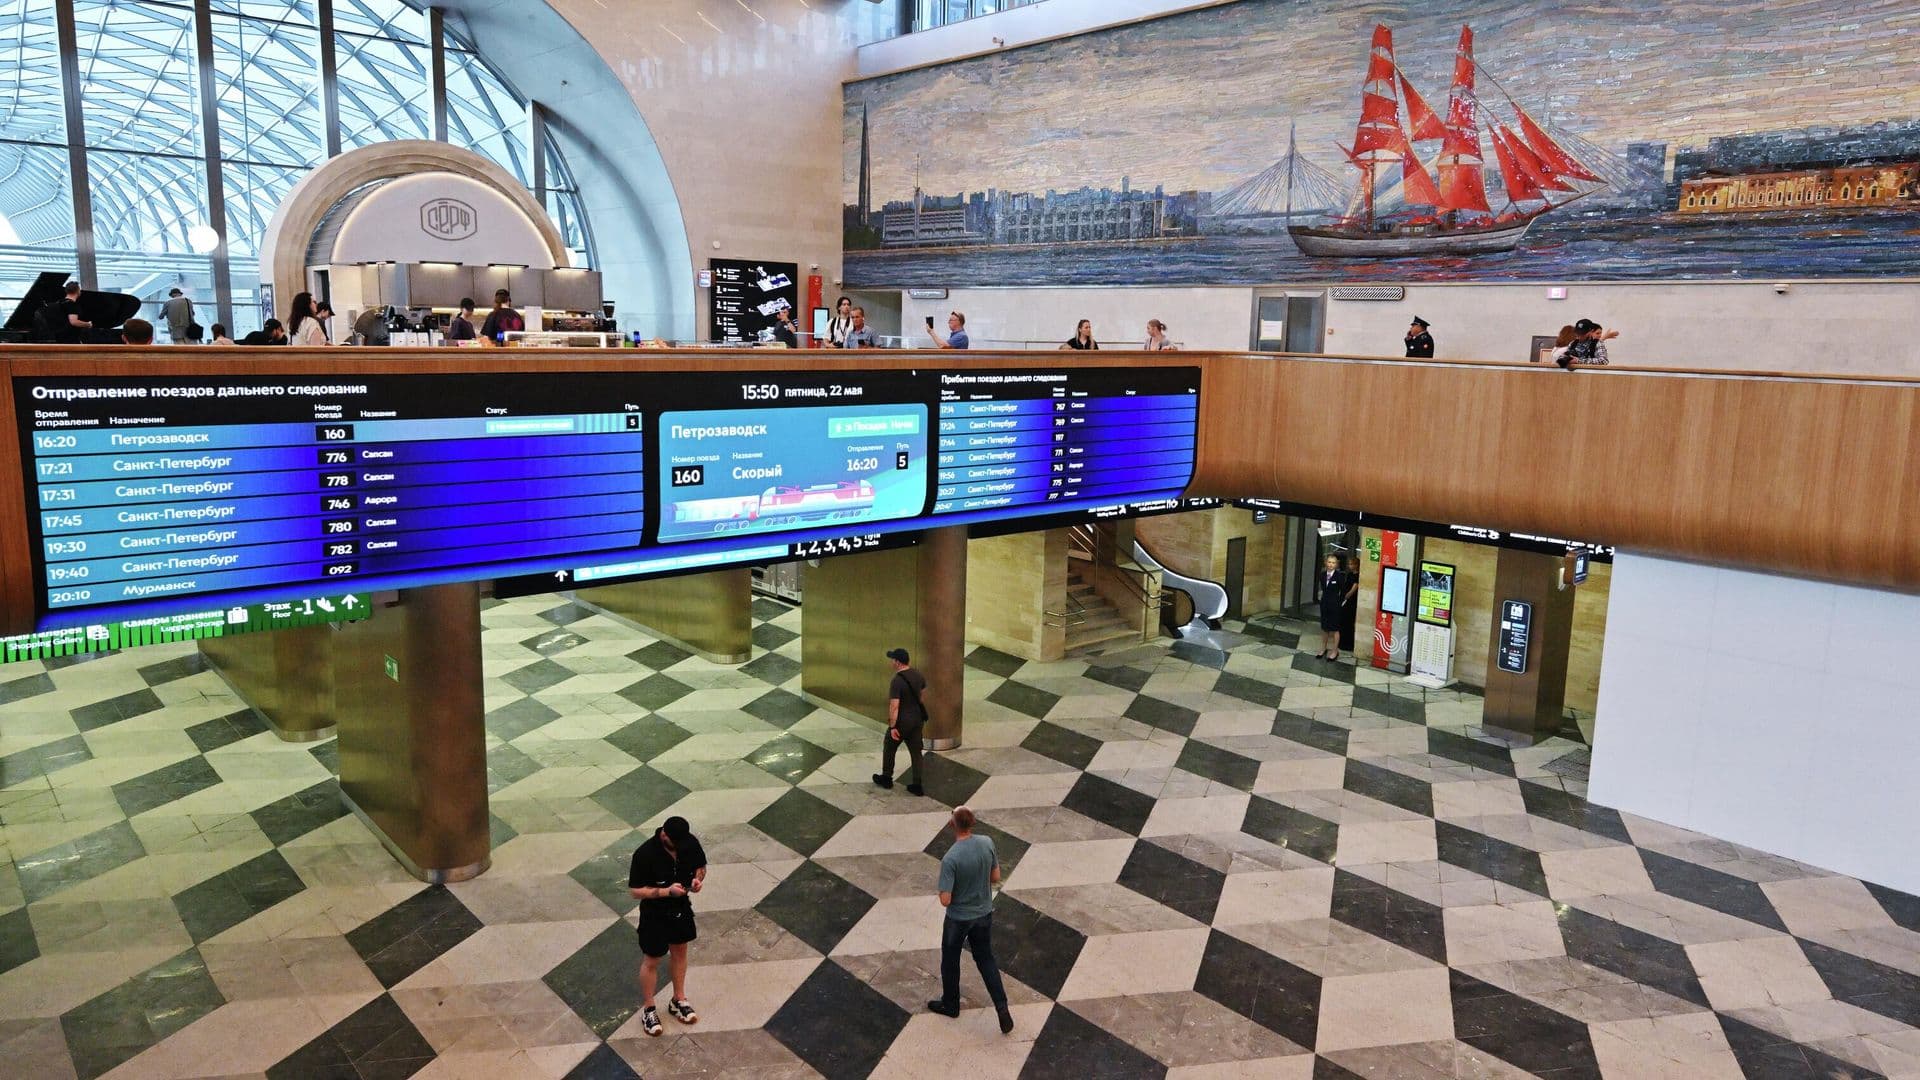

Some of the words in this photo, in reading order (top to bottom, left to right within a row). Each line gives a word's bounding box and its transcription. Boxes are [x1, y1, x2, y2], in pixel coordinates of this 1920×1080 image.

[32, 387, 147, 400] Отправление
[151, 388, 214, 397] поездов
[218, 387, 284, 397] дальнего
[288, 386, 367, 395] следования
[742, 385, 779, 399] 15:50
[785, 388, 827, 397] пятница,
[830, 385, 842, 395] 22
[844, 387, 862, 395] мая
[35, 410, 68, 419] Время
[36, 418, 99, 427] отправления
[325, 429, 345, 439] 160
[672, 426, 766, 440] Петрозаводск
[38, 436, 76, 447] 16:20
[112, 434, 209, 446] Петрозаводск
[114, 457, 231, 471] Санкт-Петербург
[326, 453, 347, 463] 776
[899, 456, 905, 467] 5
[40, 463, 72, 474] 17:21
[848, 458, 878, 471] 16:20
[675, 470, 700, 483] 160
[733, 465, 782, 479] Скорый
[327, 476, 348, 486] 778
[116, 481, 233, 496] Санкт-Петербург
[43, 489, 75, 501] 17:31
[328, 499, 350, 509] 746
[118, 506, 235, 522] Санкт-Петербург
[45, 515, 82, 528] 17:45
[329, 522, 352, 532] 780
[120, 530, 237, 548] Санкт-Петербург
[48, 541, 86, 554] 19:30
[331, 545, 352, 555] 782
[122, 554, 238, 573] Санкт-Петербург
[330, 565, 352, 574] 092
[50, 567, 88, 579] 19:40
[123, 581, 196, 595] Мурманск
[52, 591, 90, 602] 20:10
[263, 602, 291, 612] Этаж
[294, 599, 314, 616] -1
[122, 617, 170, 628] Камеры
[171, 610, 224, 622] хранения
[272, 610, 292, 619] Floor
[161, 623, 194, 633] Luggage
[9, 638, 51, 650] Shopping
[53, 636, 84, 647] Gallery
